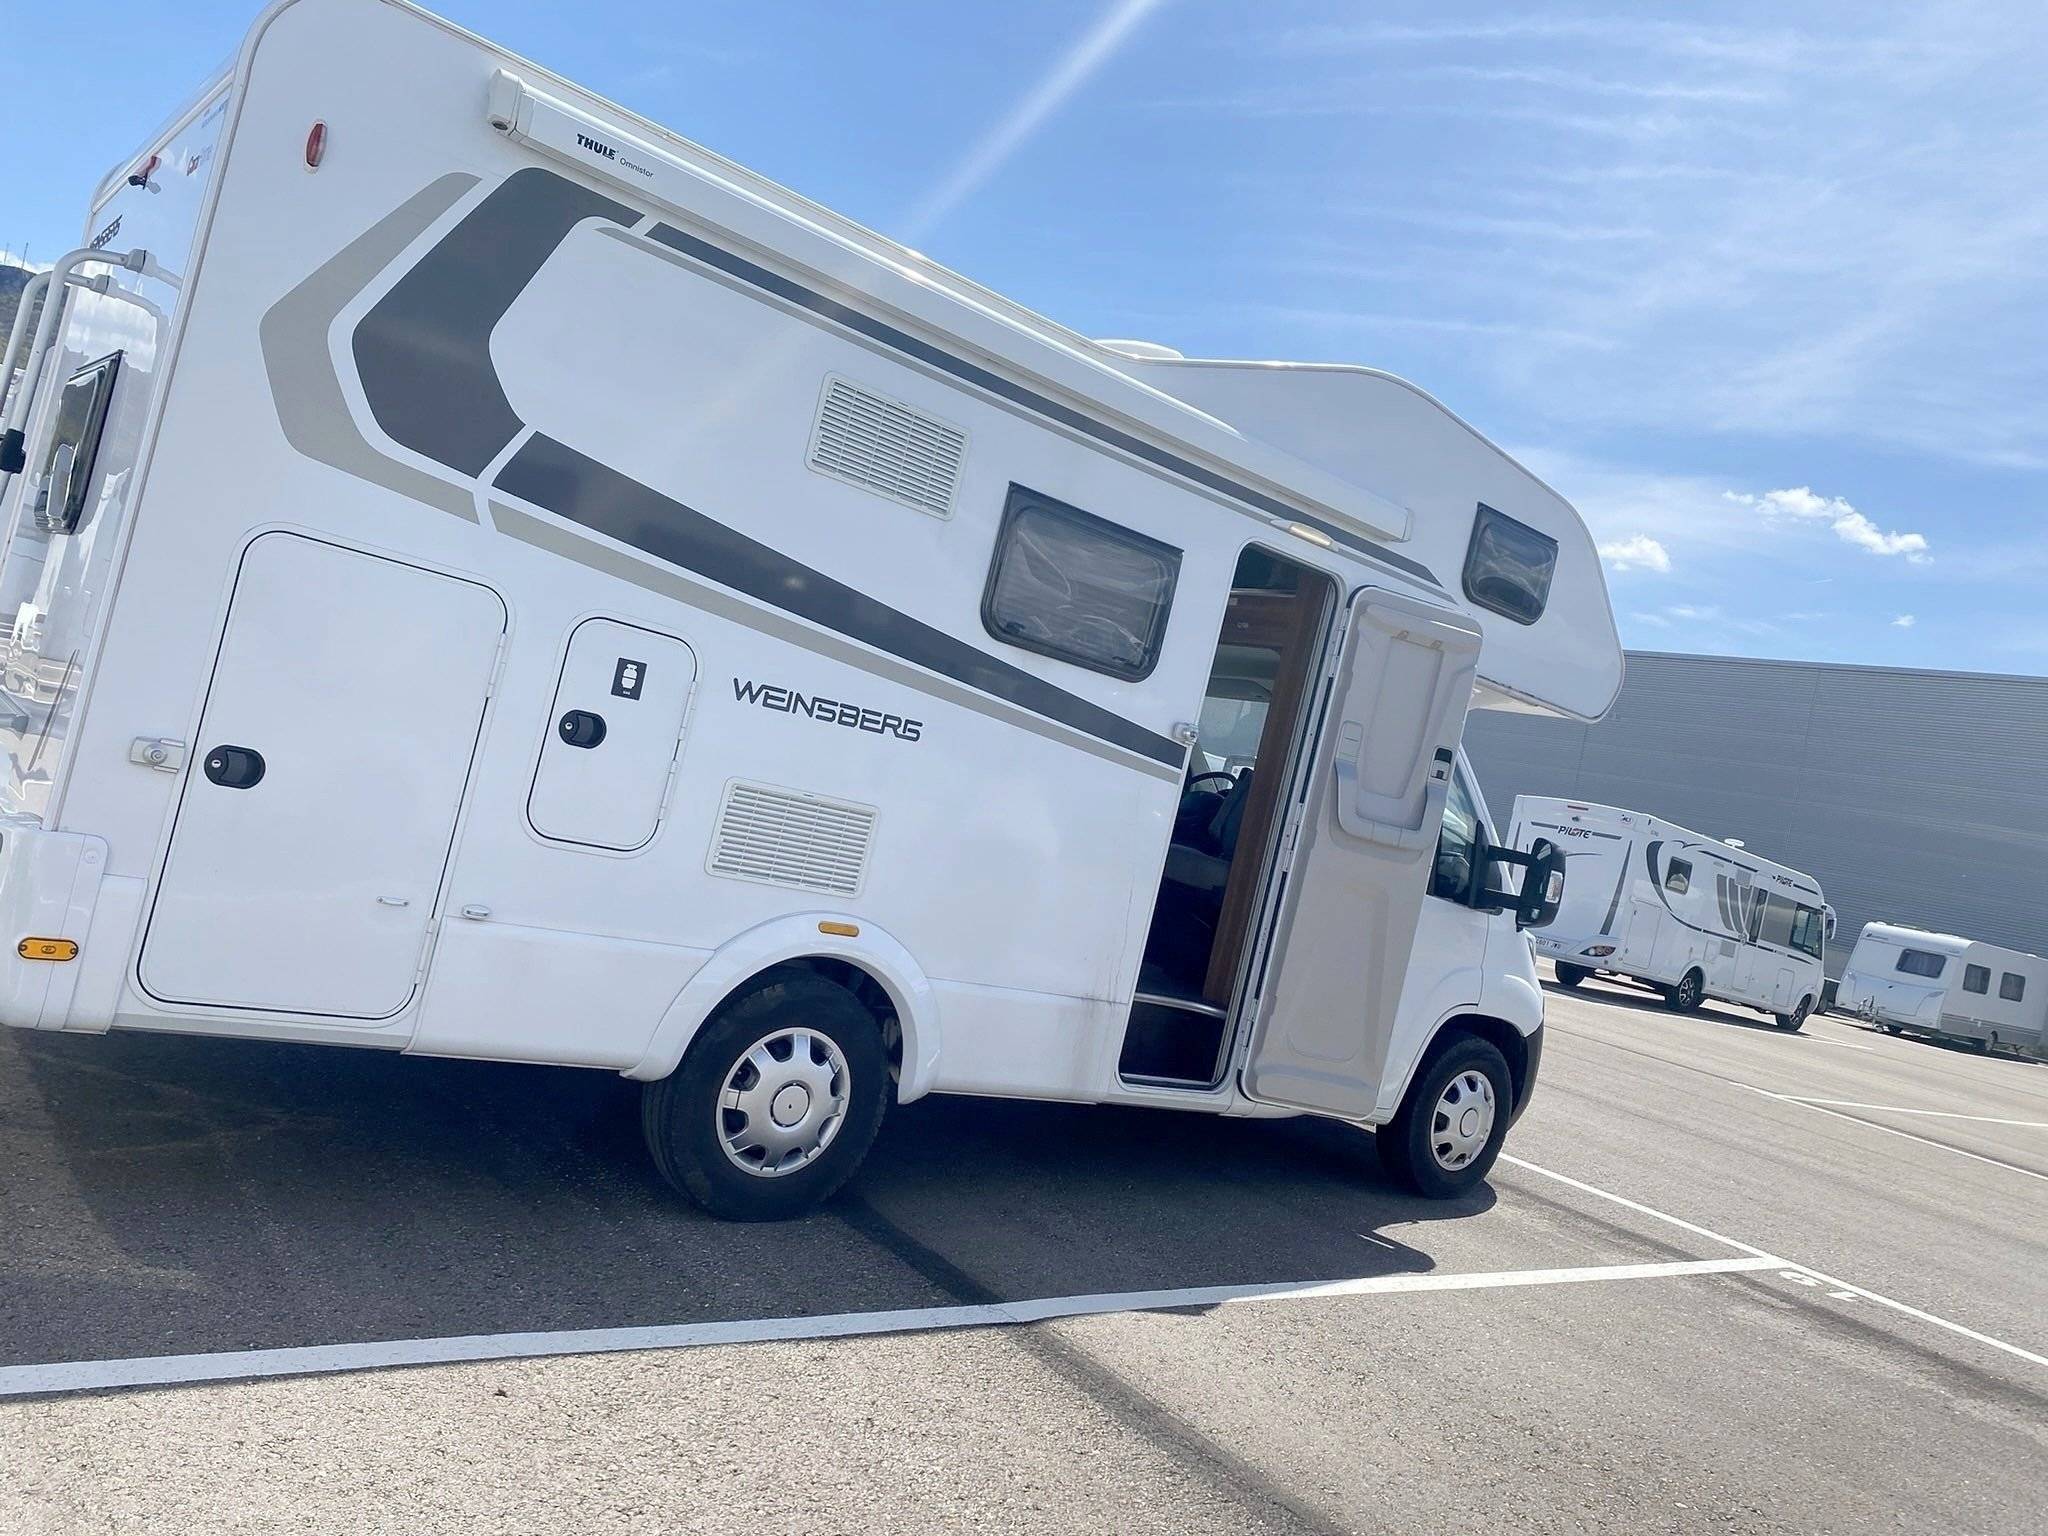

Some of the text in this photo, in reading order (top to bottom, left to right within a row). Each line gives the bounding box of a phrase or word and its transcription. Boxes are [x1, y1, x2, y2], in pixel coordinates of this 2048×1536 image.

[577, 133, 654, 178] THULE Omnistor
[733, 677, 923, 742] WEINSBERG
[1558, 825, 1592, 839] PILOTE
